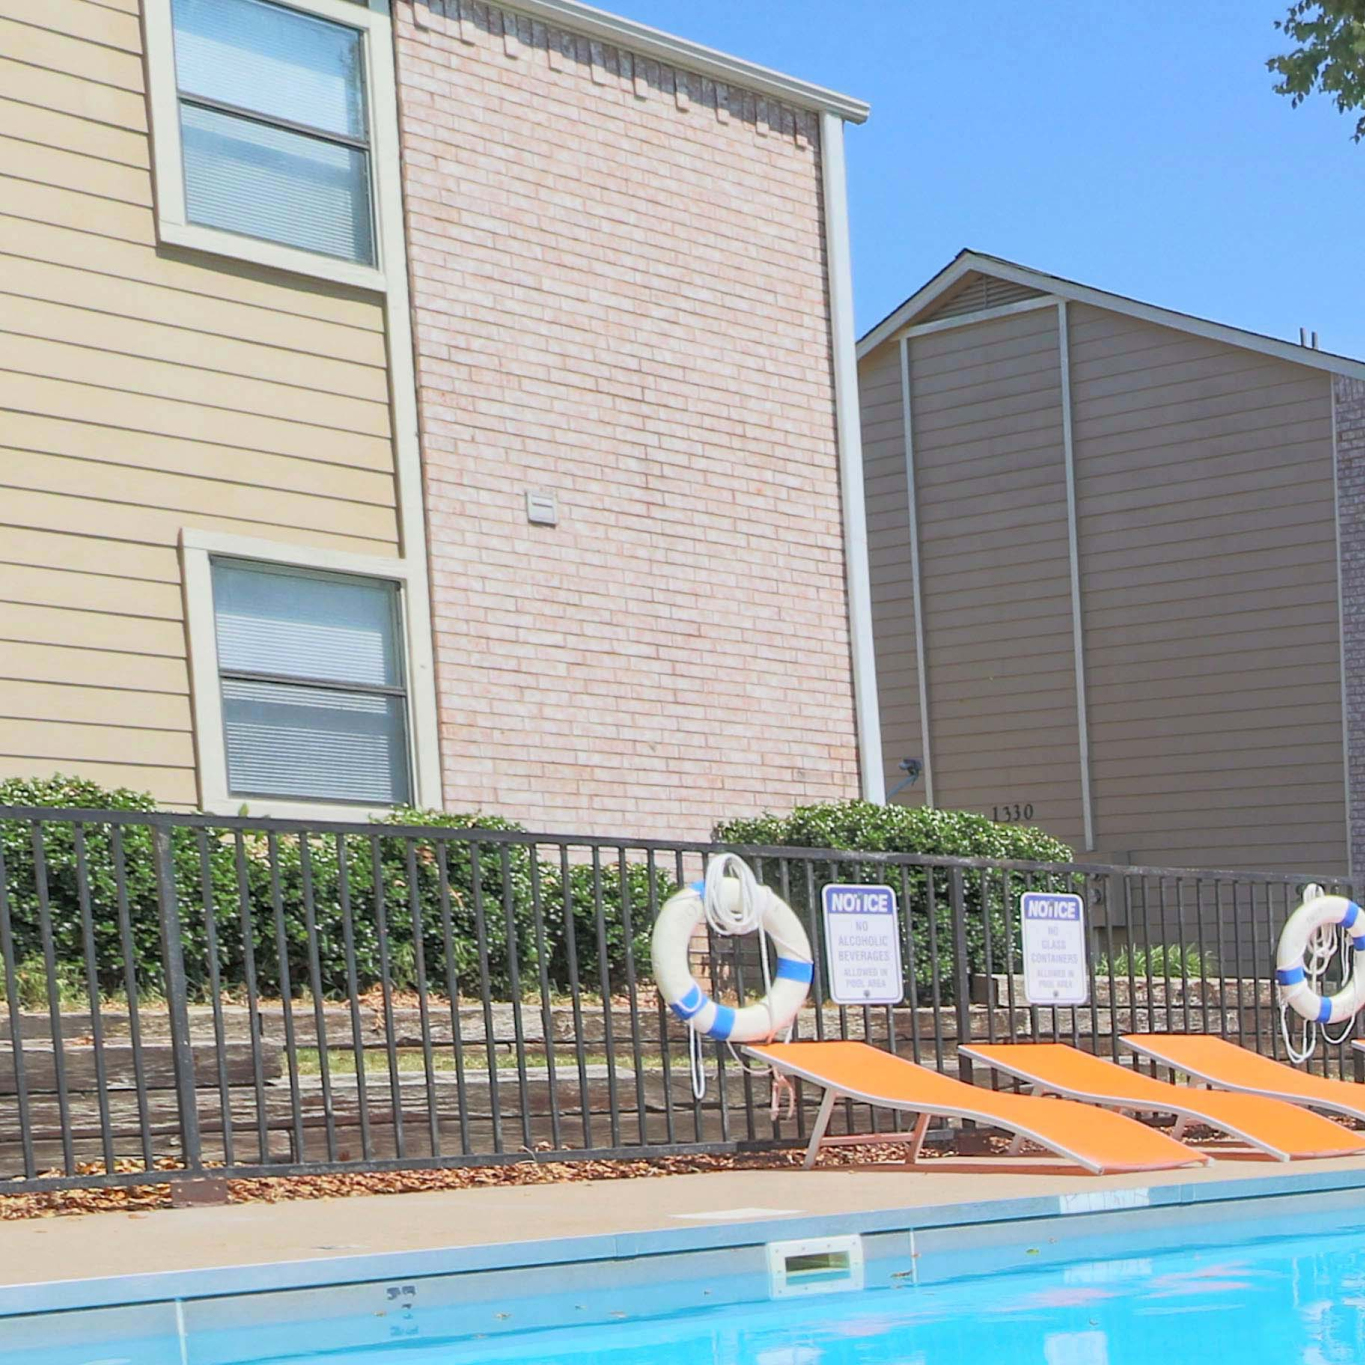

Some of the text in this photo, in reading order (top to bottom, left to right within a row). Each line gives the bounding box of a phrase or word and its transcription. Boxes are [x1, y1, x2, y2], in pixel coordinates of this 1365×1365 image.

[993, 804, 1034, 822] 1330
[831, 893, 888, 912] NOTICE
[1028, 900, 1076, 918] NOTICE
[855, 920, 869, 931] NO
[838, 936, 888, 946] ALCOHOLIC
[838, 950, 890, 961] BEVERAGES
[1031, 954, 1078, 964] CONTAINERS
[844, 968, 878, 977] ALLOWED
